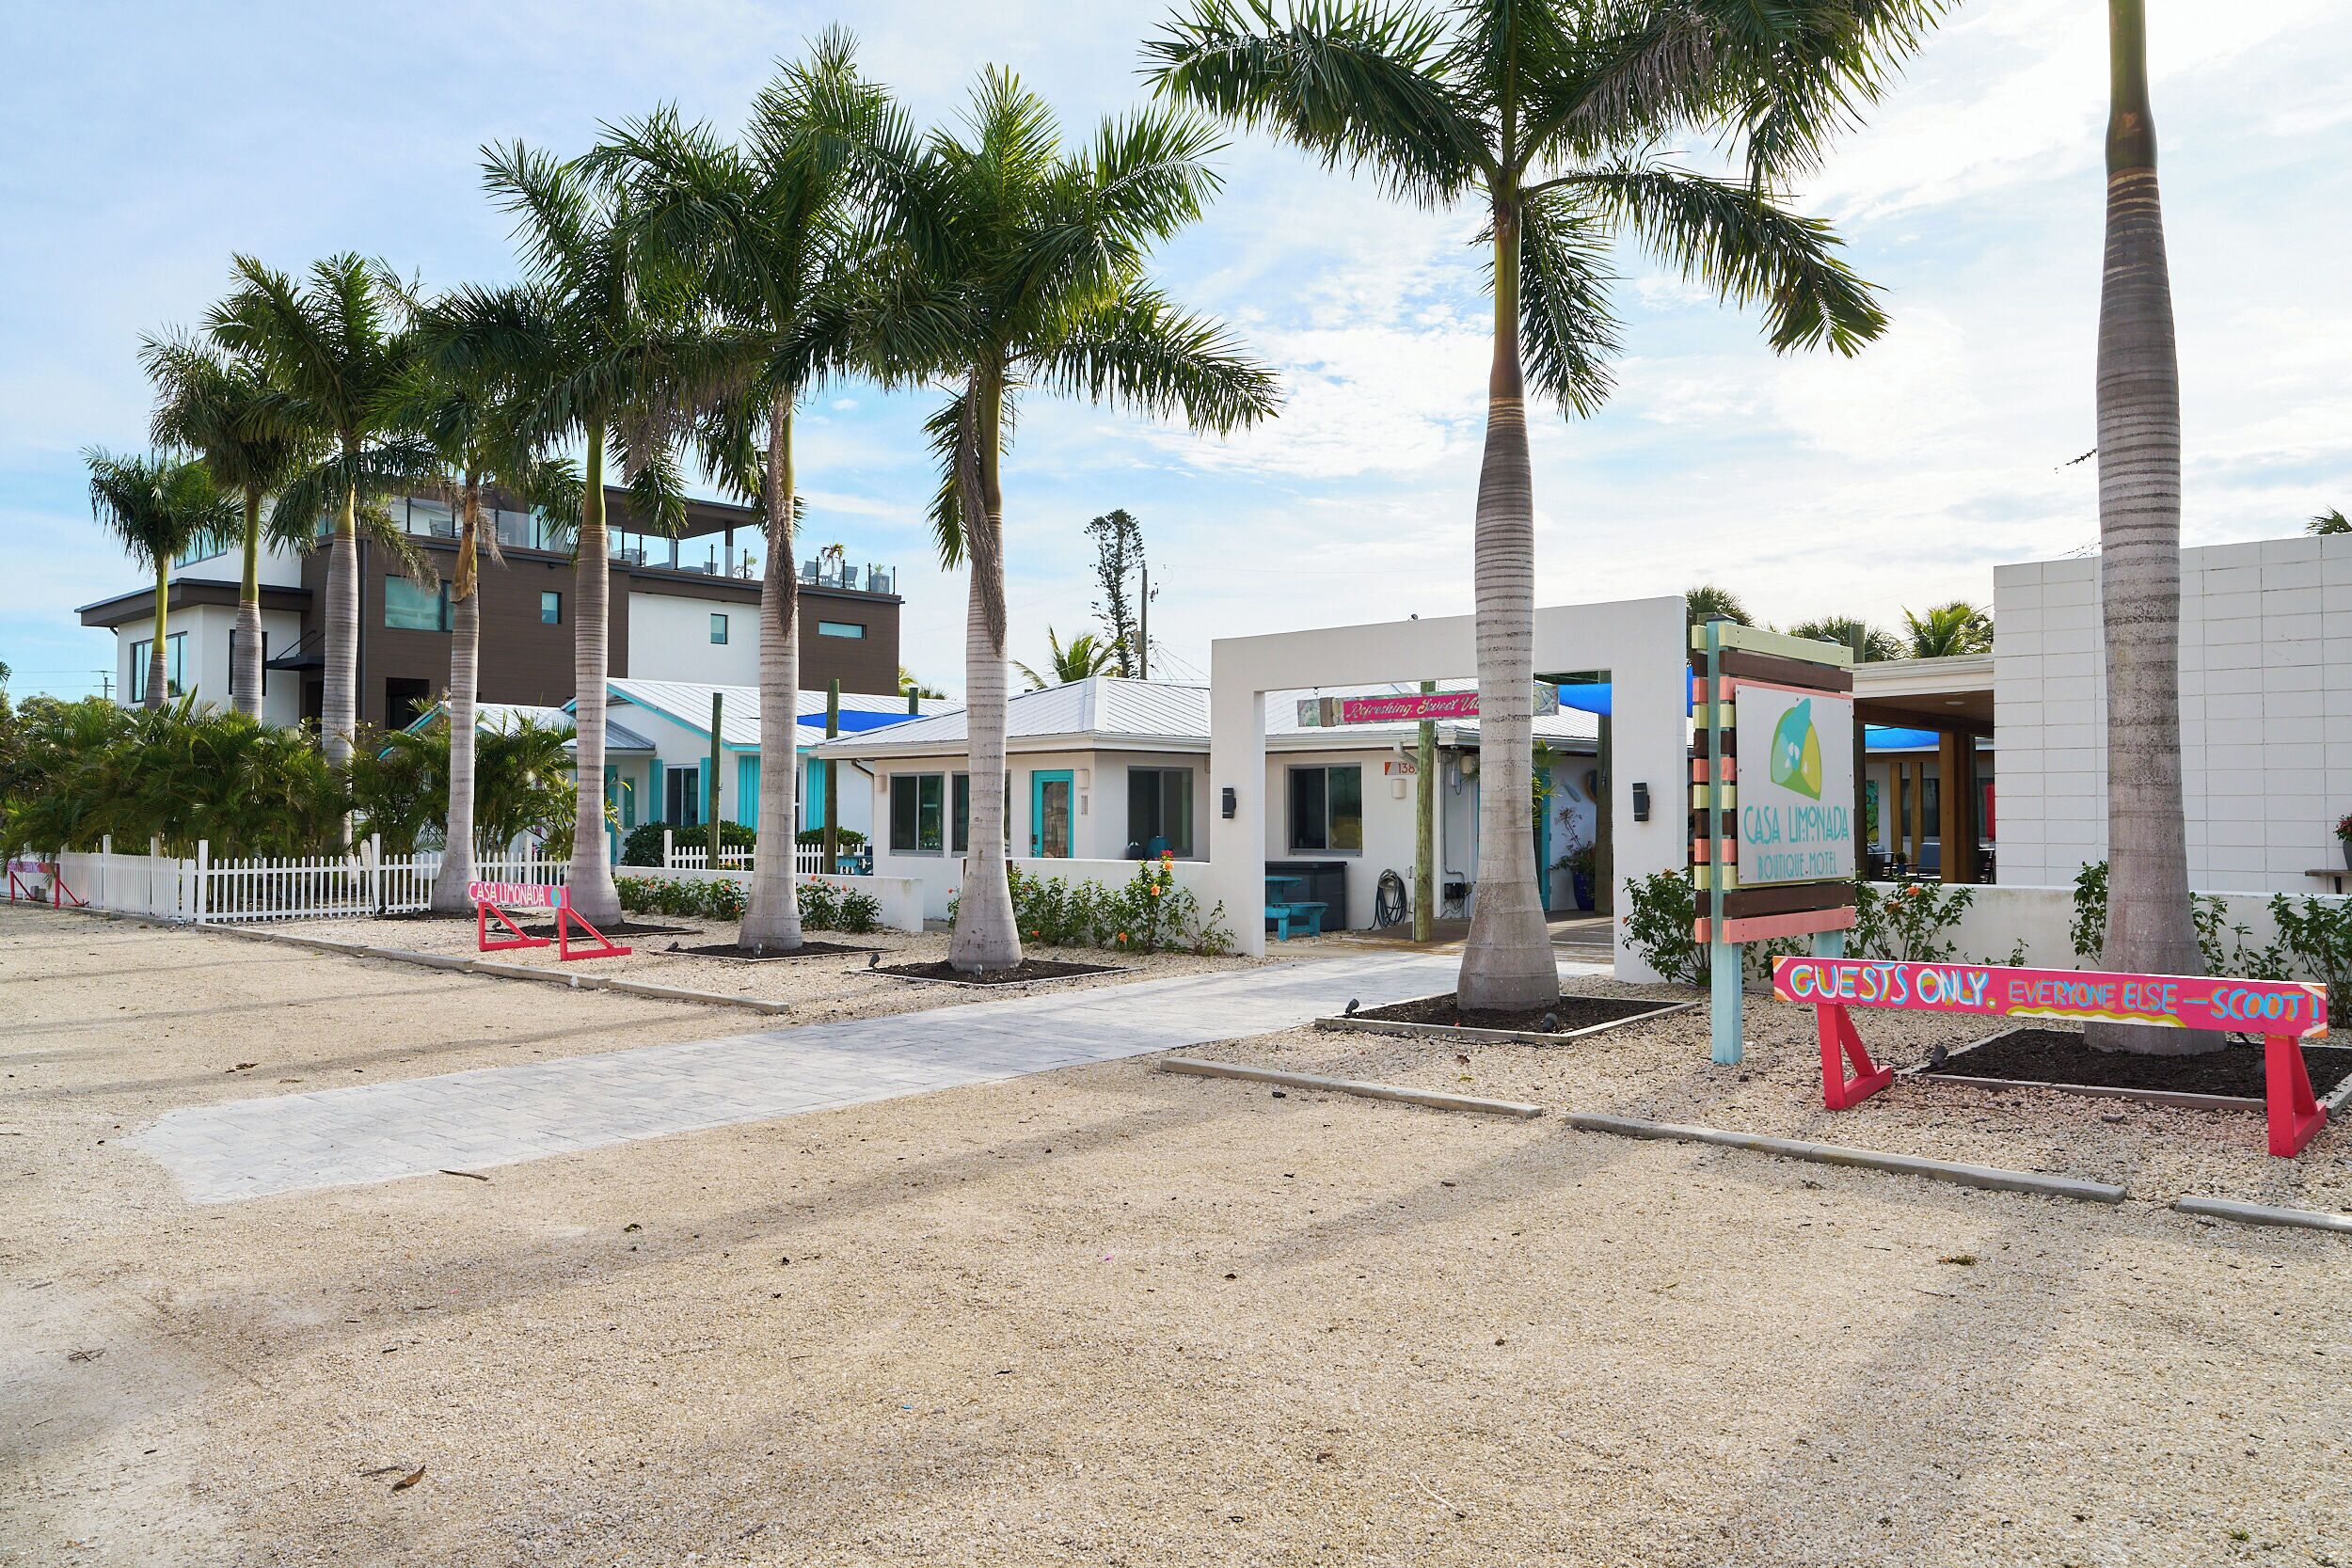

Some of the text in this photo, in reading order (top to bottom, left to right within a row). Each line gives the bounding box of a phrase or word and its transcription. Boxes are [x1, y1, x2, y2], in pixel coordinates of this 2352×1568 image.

[1417, 698, 1457, 715] Sweet
[1743, 803, 1850, 845] CASA LIMONADA
[1756, 850, 1837, 881] BOUTIQUE MOTEL
[469, 882, 546, 907] CASA LIMONADA
[1789, 962, 1910, 1005] GUESTS
[2008, 980, 2116, 1008] EVERYONE
[2121, 982, 2178, 1014] ELSE
